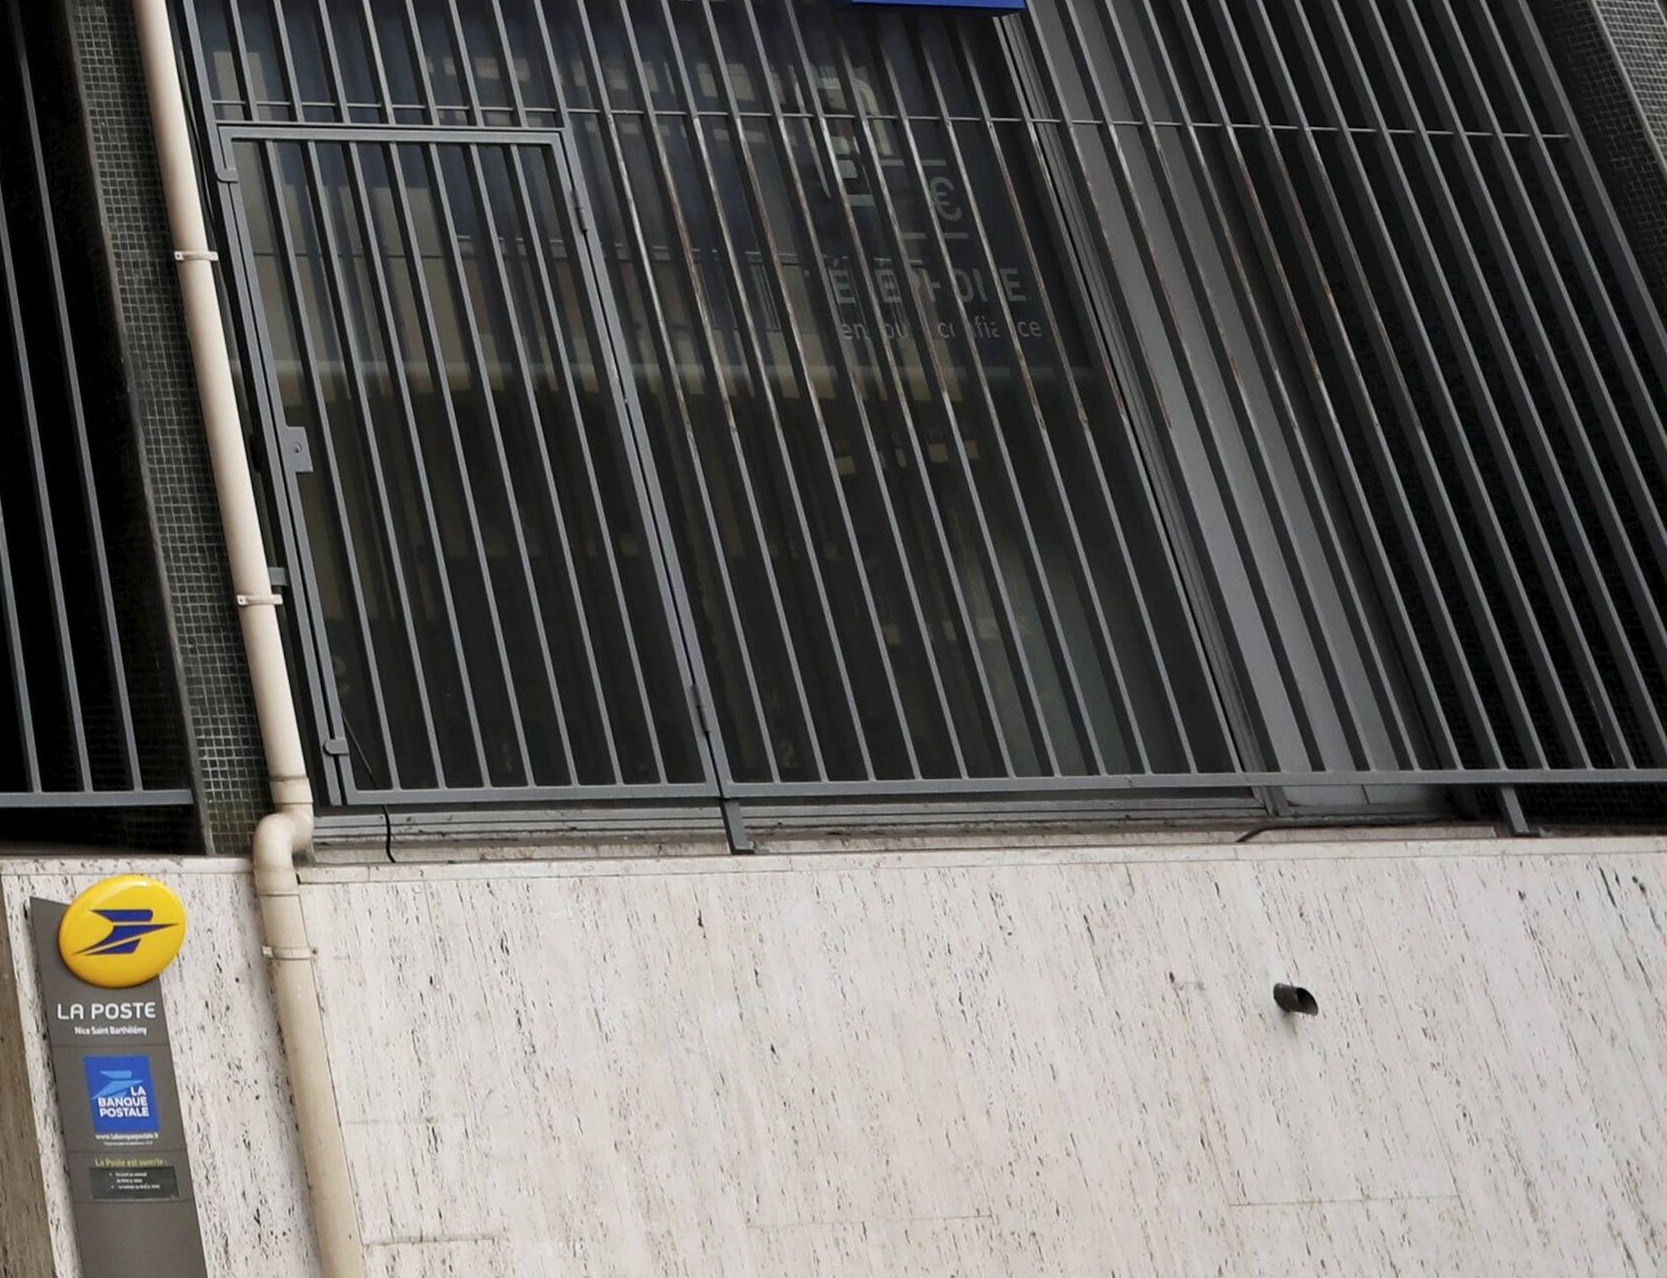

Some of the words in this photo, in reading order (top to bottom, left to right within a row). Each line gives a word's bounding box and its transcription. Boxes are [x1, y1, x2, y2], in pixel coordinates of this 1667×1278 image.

[57, 1003, 84, 1020] LA
[91, 1002, 156, 1020] POSTE
[130, 1085, 146, 1096] LA
[98, 1096, 148, 1107] BANQUE
[99, 1107, 150, 1118] POSTALE
